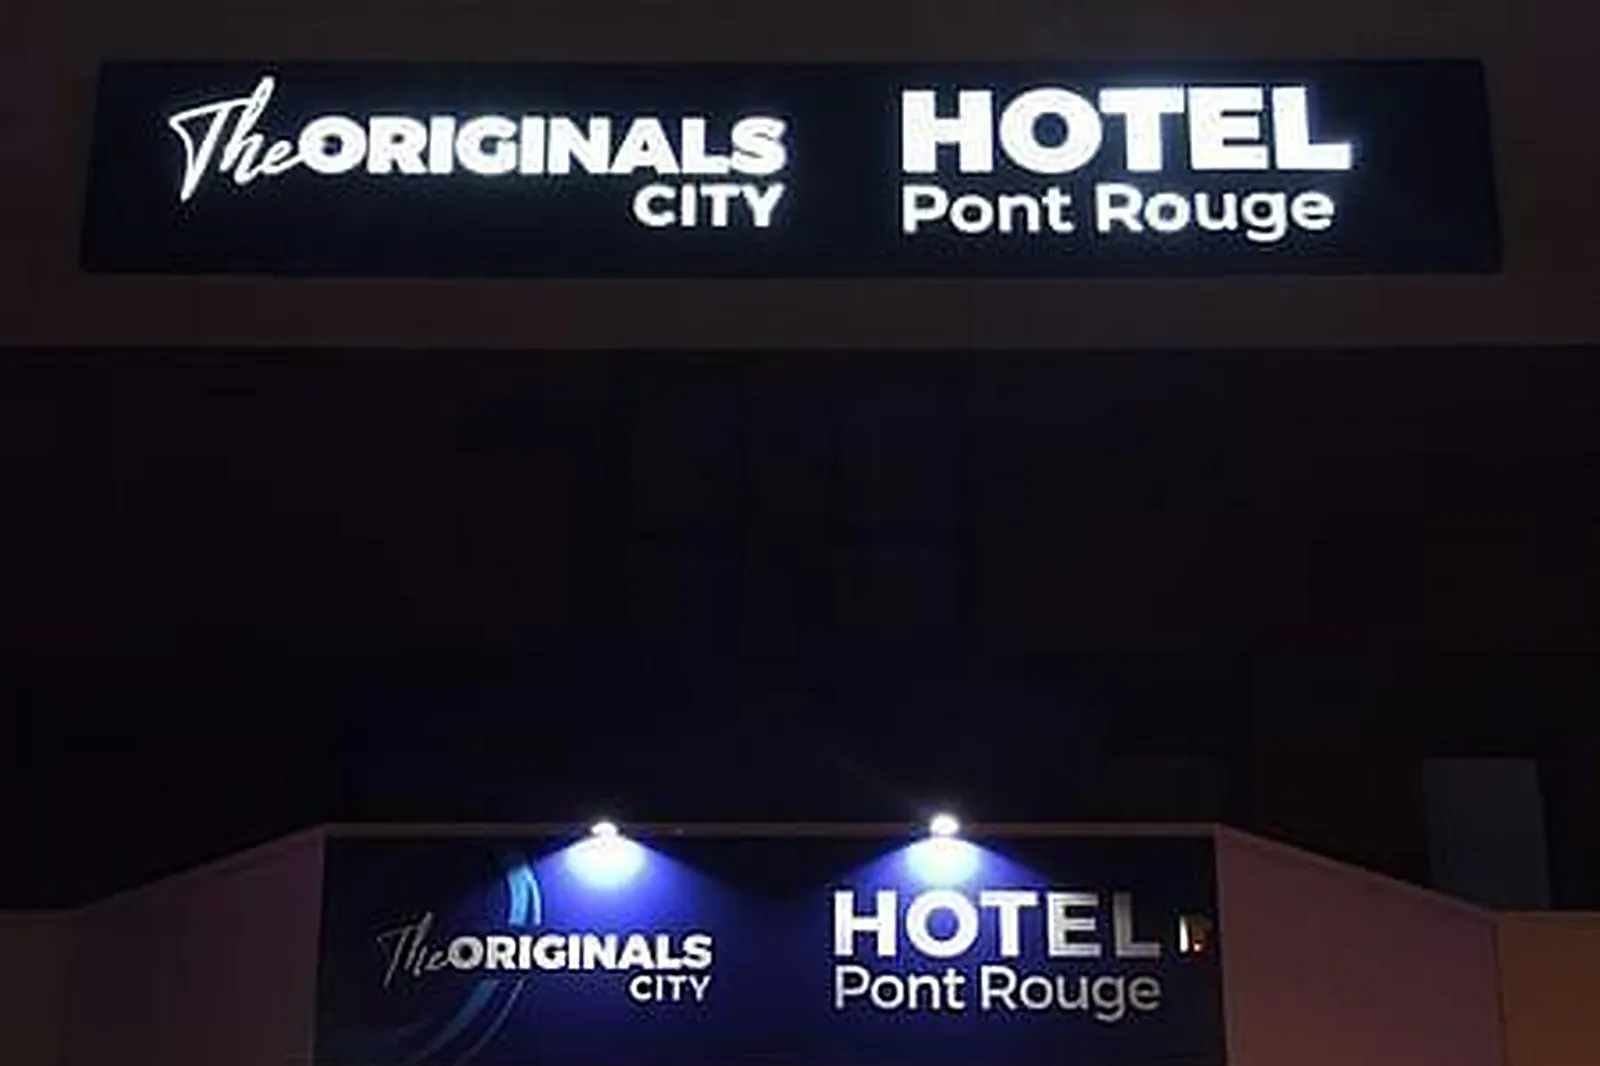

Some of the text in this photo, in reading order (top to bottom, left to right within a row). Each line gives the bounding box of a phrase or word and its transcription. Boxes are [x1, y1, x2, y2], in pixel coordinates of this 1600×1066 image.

[298, 114, 788, 177] ORIGINALS
[901, 84, 1354, 175] HOTEL
[632, 182, 786, 229] CITY
[902, 182, 1336, 243] Pont Rouge
[448, 933, 713, 971] ORIGINALS
[833, 887, 1162, 959] HOTEL
[628, 974, 712, 1002] CITY
[835, 964, 1162, 1022] Pont Rouge
